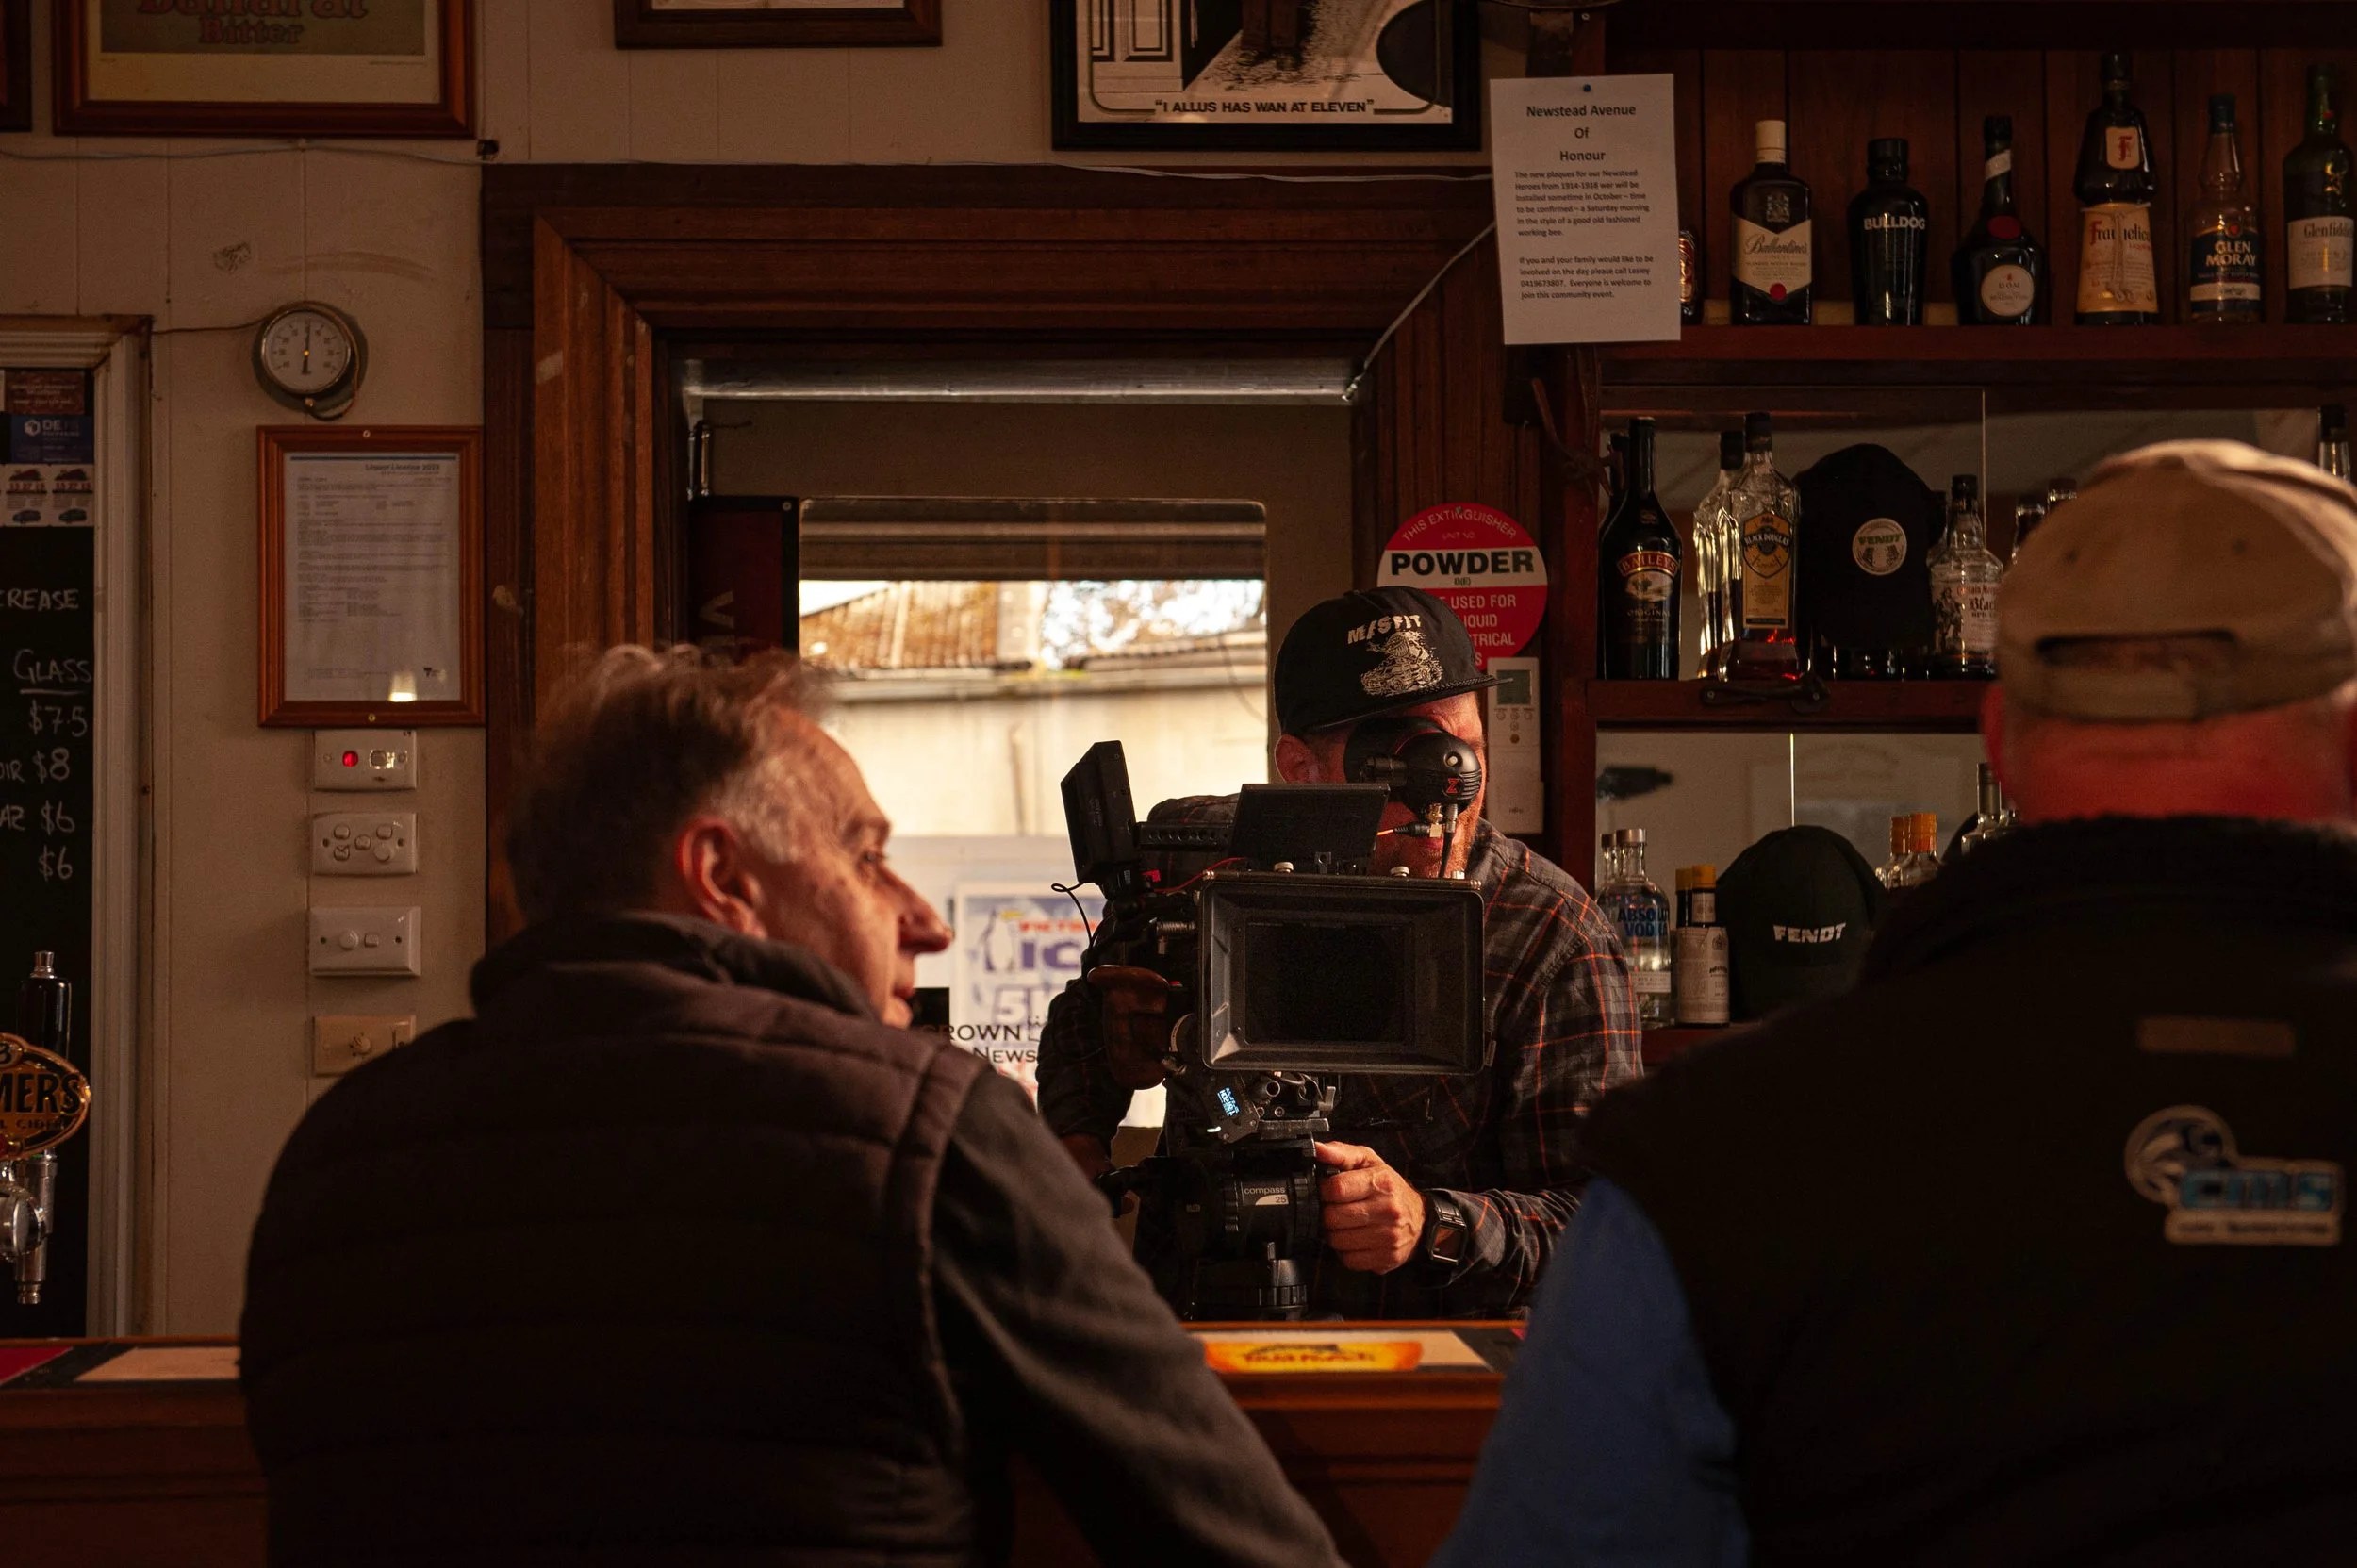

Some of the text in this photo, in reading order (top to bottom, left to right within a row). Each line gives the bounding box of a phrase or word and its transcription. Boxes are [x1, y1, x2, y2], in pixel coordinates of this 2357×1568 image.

[198, 15, 303, 44] Bitter
[1172, 101, 1217, 113] ALLUS
[1222, 101, 1251, 113] HAS
[1254, 101, 1288, 113] WAN
[1290, 101, 1309, 113] AT
[1526, 105, 1637, 117] Newstead Avenue
[1574, 127, 1590, 139] Of
[1559, 150, 1606, 161] Honour
[1514, 171, 1528, 179] The
[1547, 171, 1574, 180] plaques
[1602, 169, 1639, 178] Newstead
[1515, 182, 1541, 190] Heroes
[1541, 181, 1559, 190] from
[1561, 181, 1598, 190] 1914-1918
[1615, 180, 1628, 189] will
[1630, 180, 1639, 189] be
[1547, 192, 1583, 202] sometime
[1593, 191, 1623, 201] October
[1629, 191, 1646, 200] time
[1537, 205, 1574, 213] confirmed
[1587, 205, 1618, 214] Saturday
[1620, 204, 1650, 213] morning
[1539, 217, 1557, 225] style
[1573, 216, 1591, 225] good
[1605, 215, 1641, 223] fashioned
[1863, 215, 1926, 231] BULLDOG
[1518, 228, 1547, 238] working
[2214, 240, 2251, 255] GLEN
[1526, 257, 1540, 266] you
[1557, 257, 1573, 266] your
[1574, 256, 1596, 265] family
[2205, 253, 2256, 267] MORAY
[1520, 268, 1551, 276] involved
[1575, 268, 1590, 276] day
[1591, 268, 1613, 276] please
[1614, 267, 1627, 275] call
[1570, 279, 1601, 289] Everyone
[1610, 278, 1641, 287] welcome
[1521, 291, 1535, 300] join
[1551, 290, 1591, 300] community
[1402, 509, 1517, 542] THIS EXTINGUISHER
[1391, 550, 1534, 576] POWDER
[1450, 593, 1517, 610] USED FOR
[1462, 613, 1498, 629] IQUID
[1471, 632, 1516, 647] TRICAL
[12, 648, 92, 685] GLASS
[32, 747, 71, 784] $8
[41, 800, 76, 836] $6
[39, 844, 74, 883] $6
[1772, 921, 1847, 944] FENDT
[1244, 1187, 1286, 1196] compass
[1275, 1196, 1287, 1204] 25
